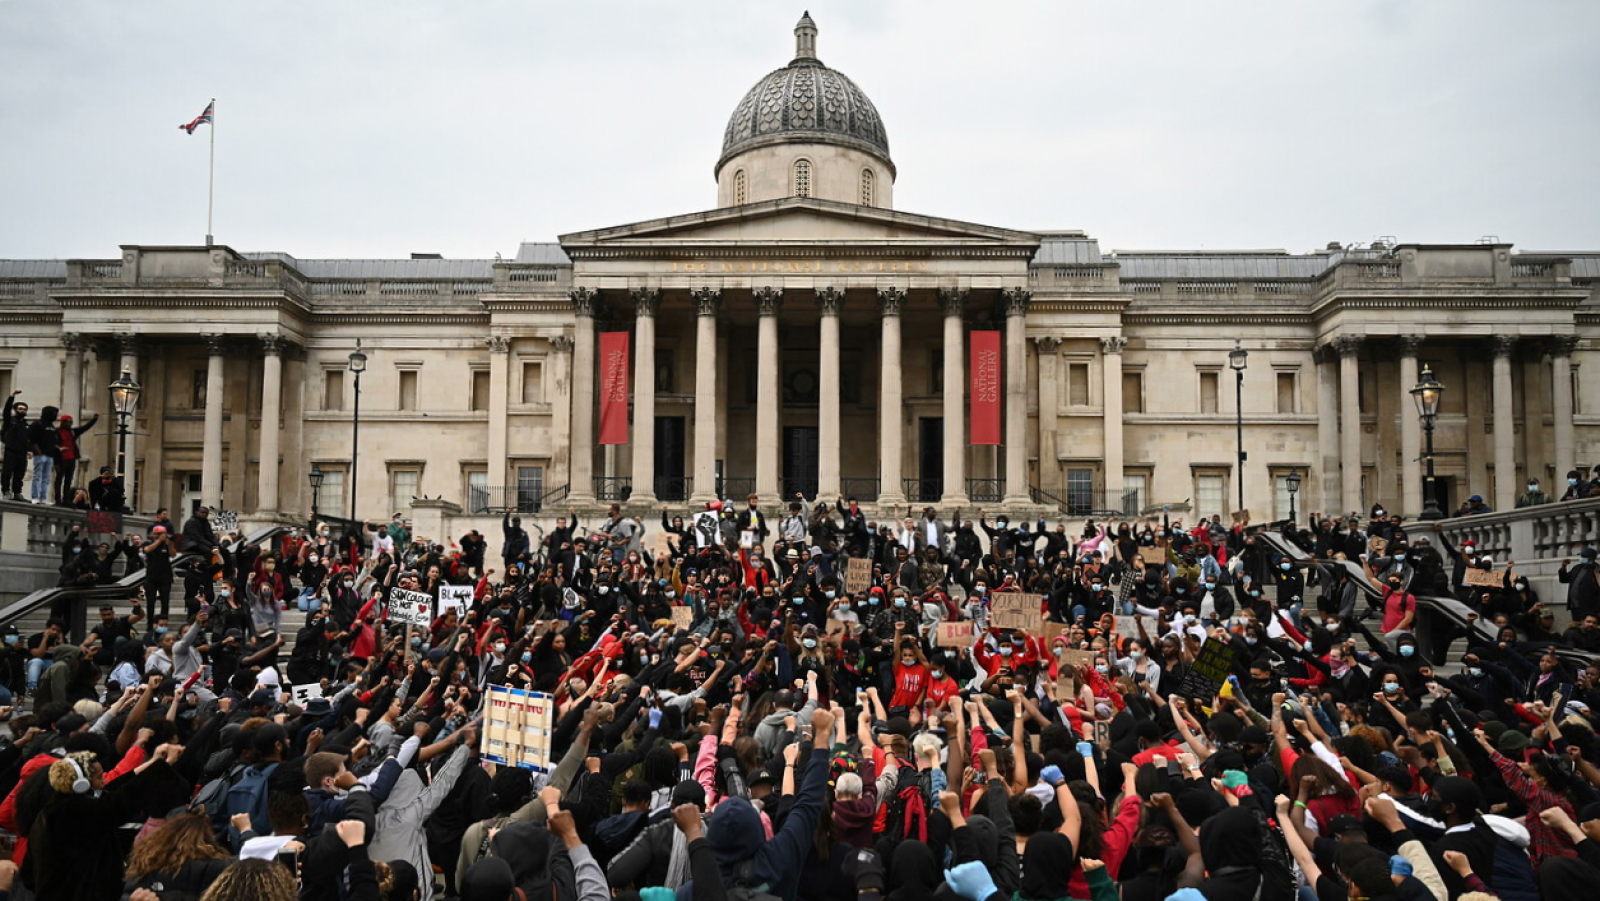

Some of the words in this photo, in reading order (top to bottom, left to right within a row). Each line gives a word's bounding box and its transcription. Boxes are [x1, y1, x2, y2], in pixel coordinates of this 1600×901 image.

[608, 351, 617, 402] NATIONAL
[616, 350, 625, 402] GALLERY
[979, 350, 987, 402] NATIONAL
[987, 348, 997, 403] GALLERY
[850, 560, 871, 570] BLACK
[850, 571, 871, 582] LIVES
[947, 625, 970, 638] BLM
